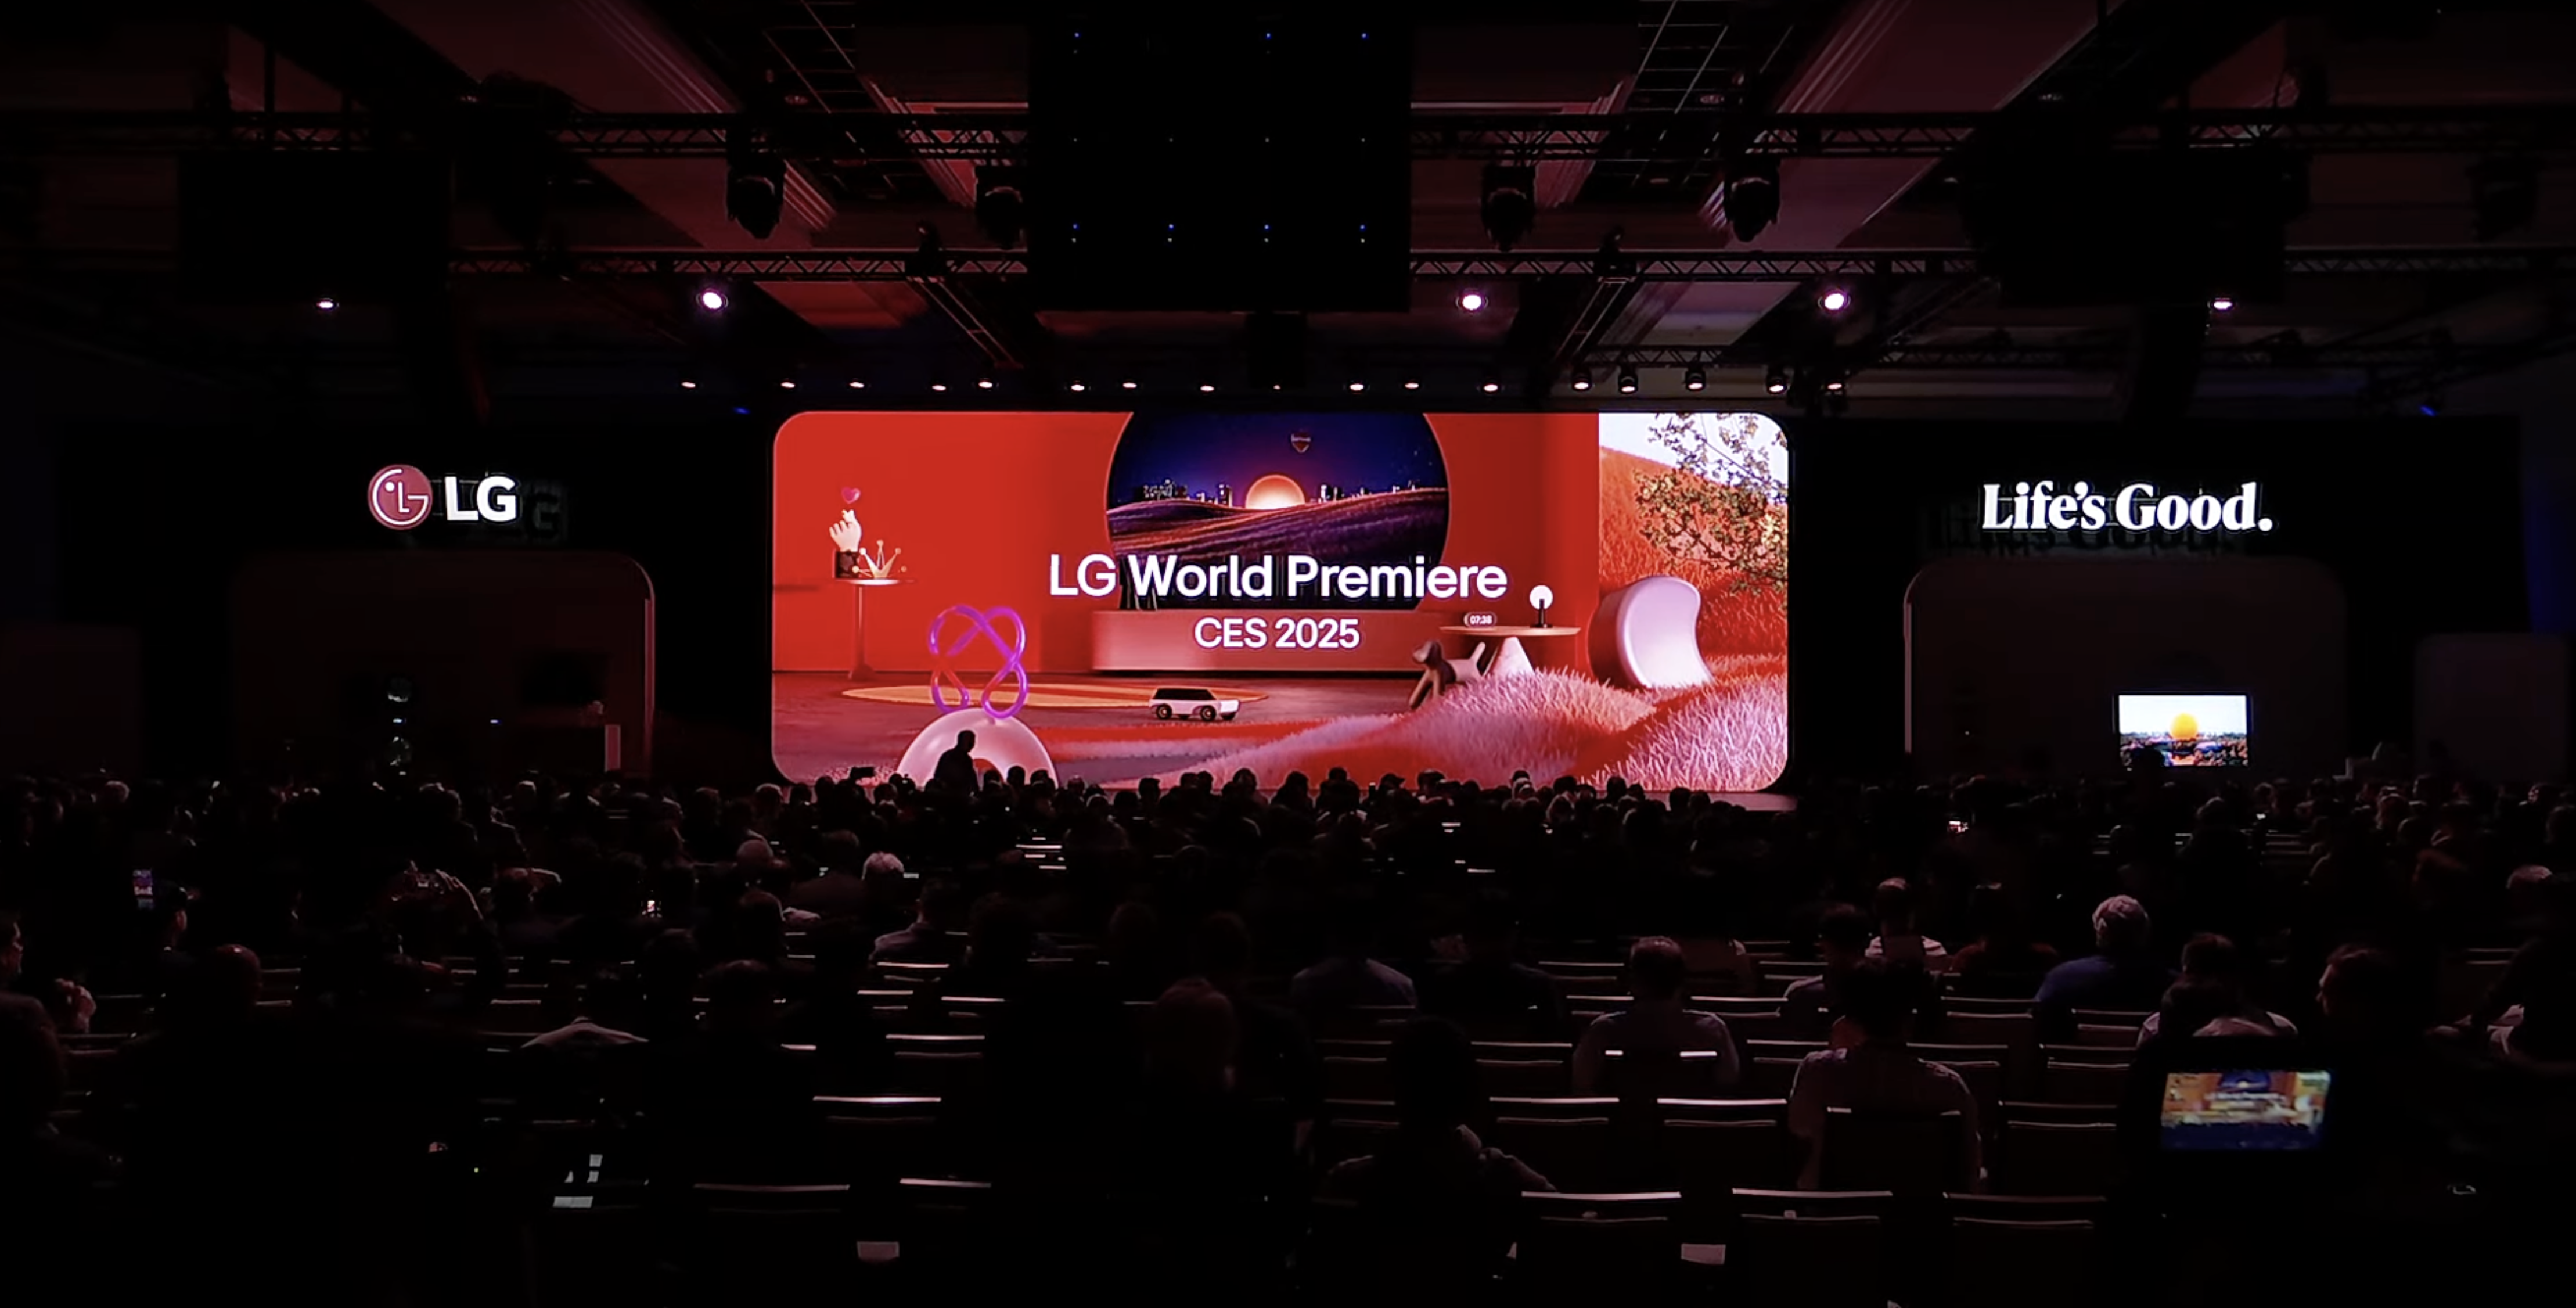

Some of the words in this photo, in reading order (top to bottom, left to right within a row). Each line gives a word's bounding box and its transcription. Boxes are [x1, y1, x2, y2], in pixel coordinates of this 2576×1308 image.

[444, 475, 517, 522] LG
[2115, 481, 2273, 531] Good.
[1050, 553, 1117, 597] LG
[1127, 554, 1273, 598] World
[1287, 555, 1508, 599] Premiere
[1194, 617, 1268, 649] CES
[1274, 617, 1360, 649] 2025
